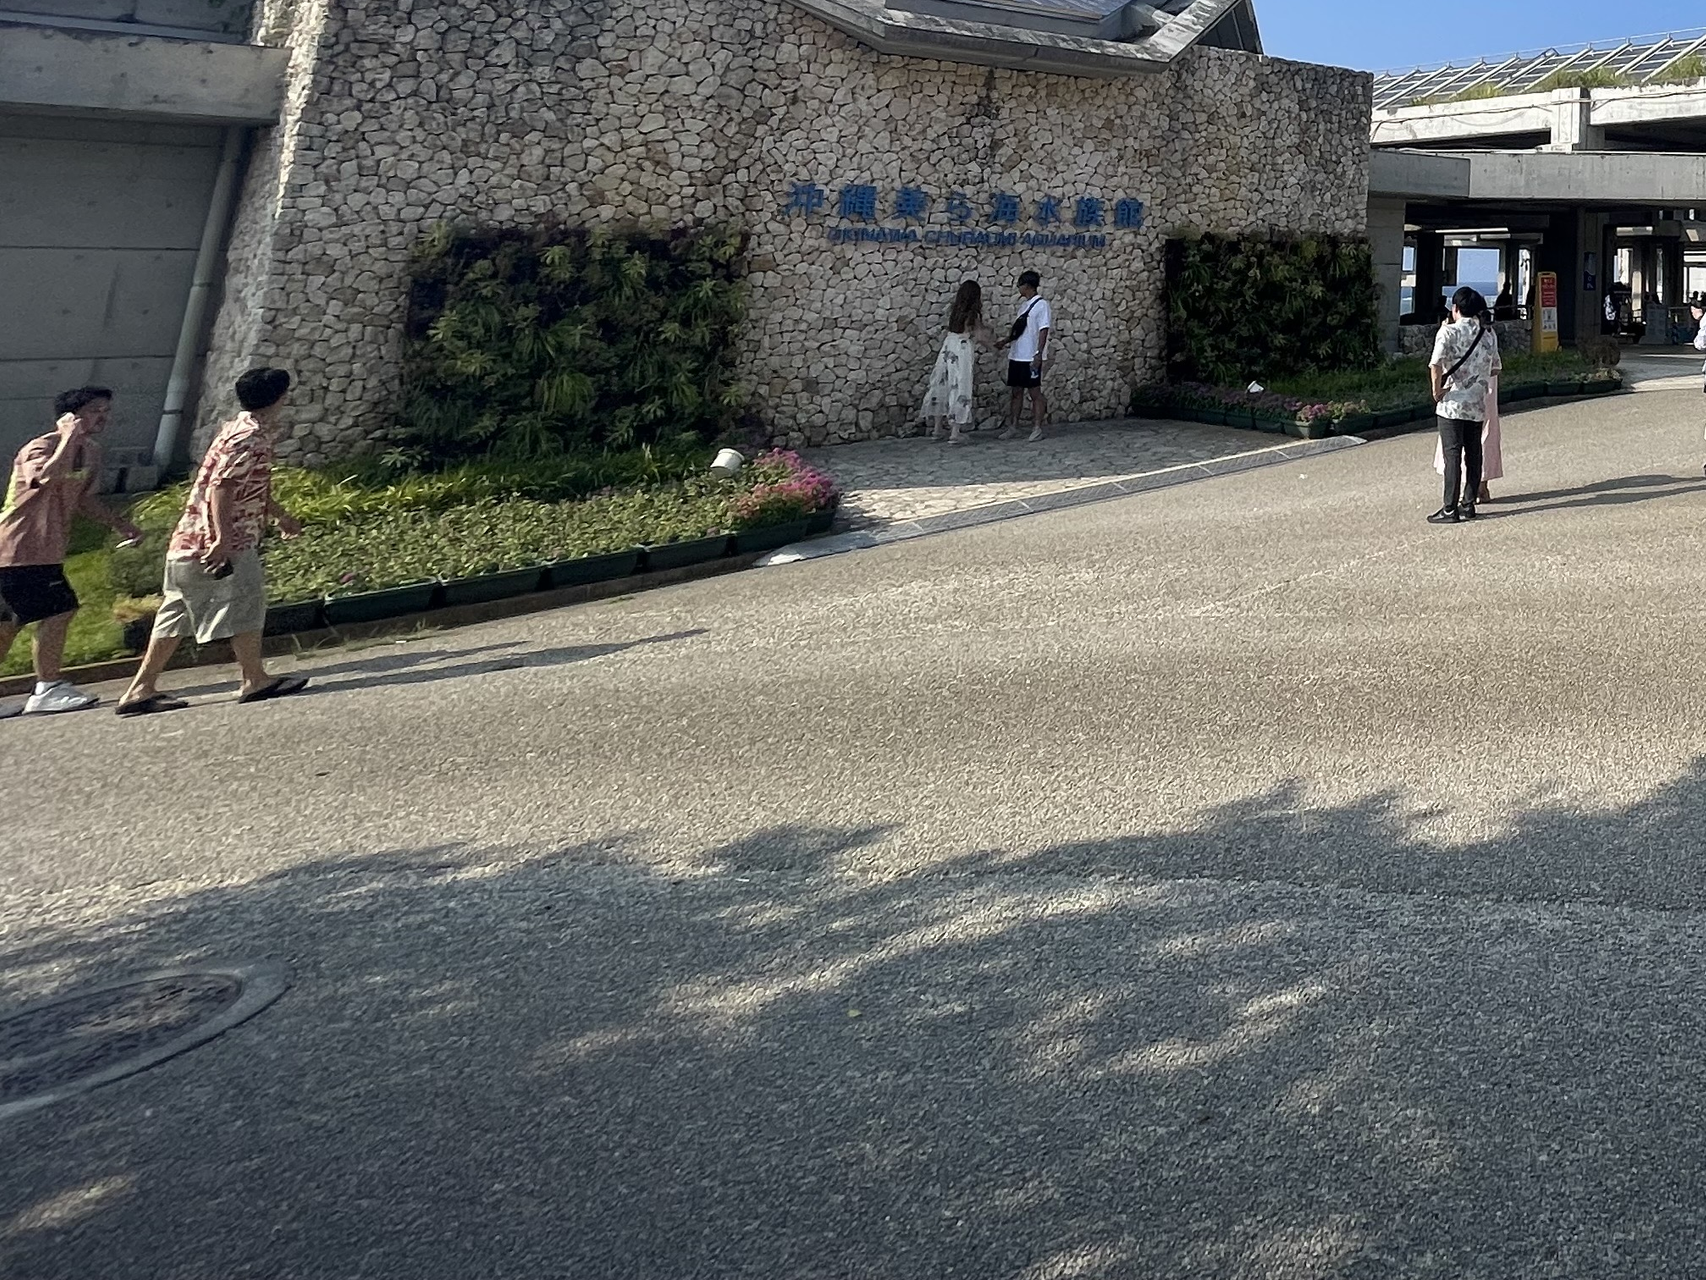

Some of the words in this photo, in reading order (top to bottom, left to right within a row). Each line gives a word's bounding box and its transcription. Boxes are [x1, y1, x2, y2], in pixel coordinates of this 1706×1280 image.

[784, 182, 1144, 228] 沖縄美ら海水族館
[827, 226, 917, 243] OKINAWA
[1021, 232, 1107, 248] AQUARIUM
